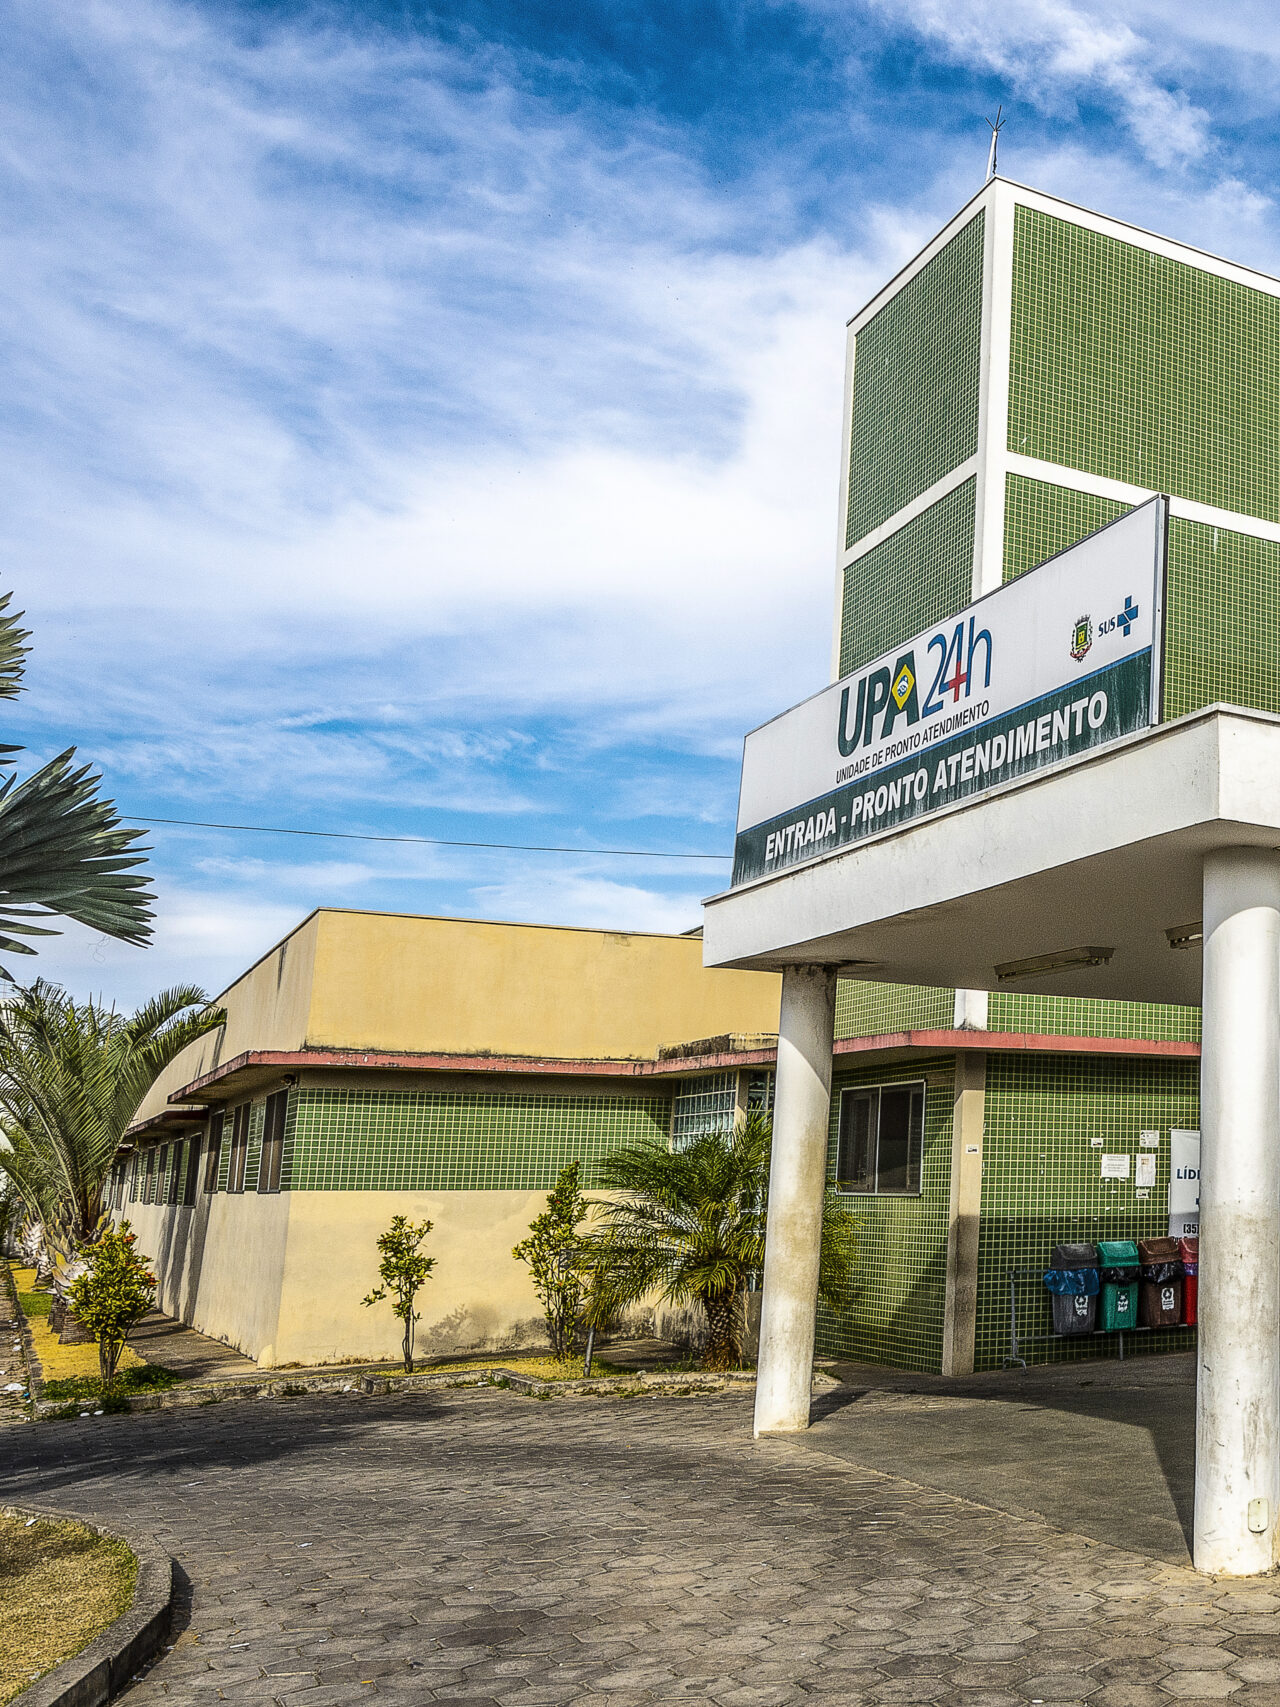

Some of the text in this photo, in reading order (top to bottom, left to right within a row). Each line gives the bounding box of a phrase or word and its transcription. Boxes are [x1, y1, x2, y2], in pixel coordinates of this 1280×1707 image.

[1098, 616, 1116, 638] SUS
[837, 615, 993, 758] UPA 24h
[765, 807, 837, 861] ENTRADA
[850, 767, 929, 826] PRONTO
[932, 690, 1108, 794] ATENDIMENTO
[836, 700, 990, 784] UNIDADE DE PRONTO ATENDIMENTO
[1177, 1165, 1200, 1180] LÍD
